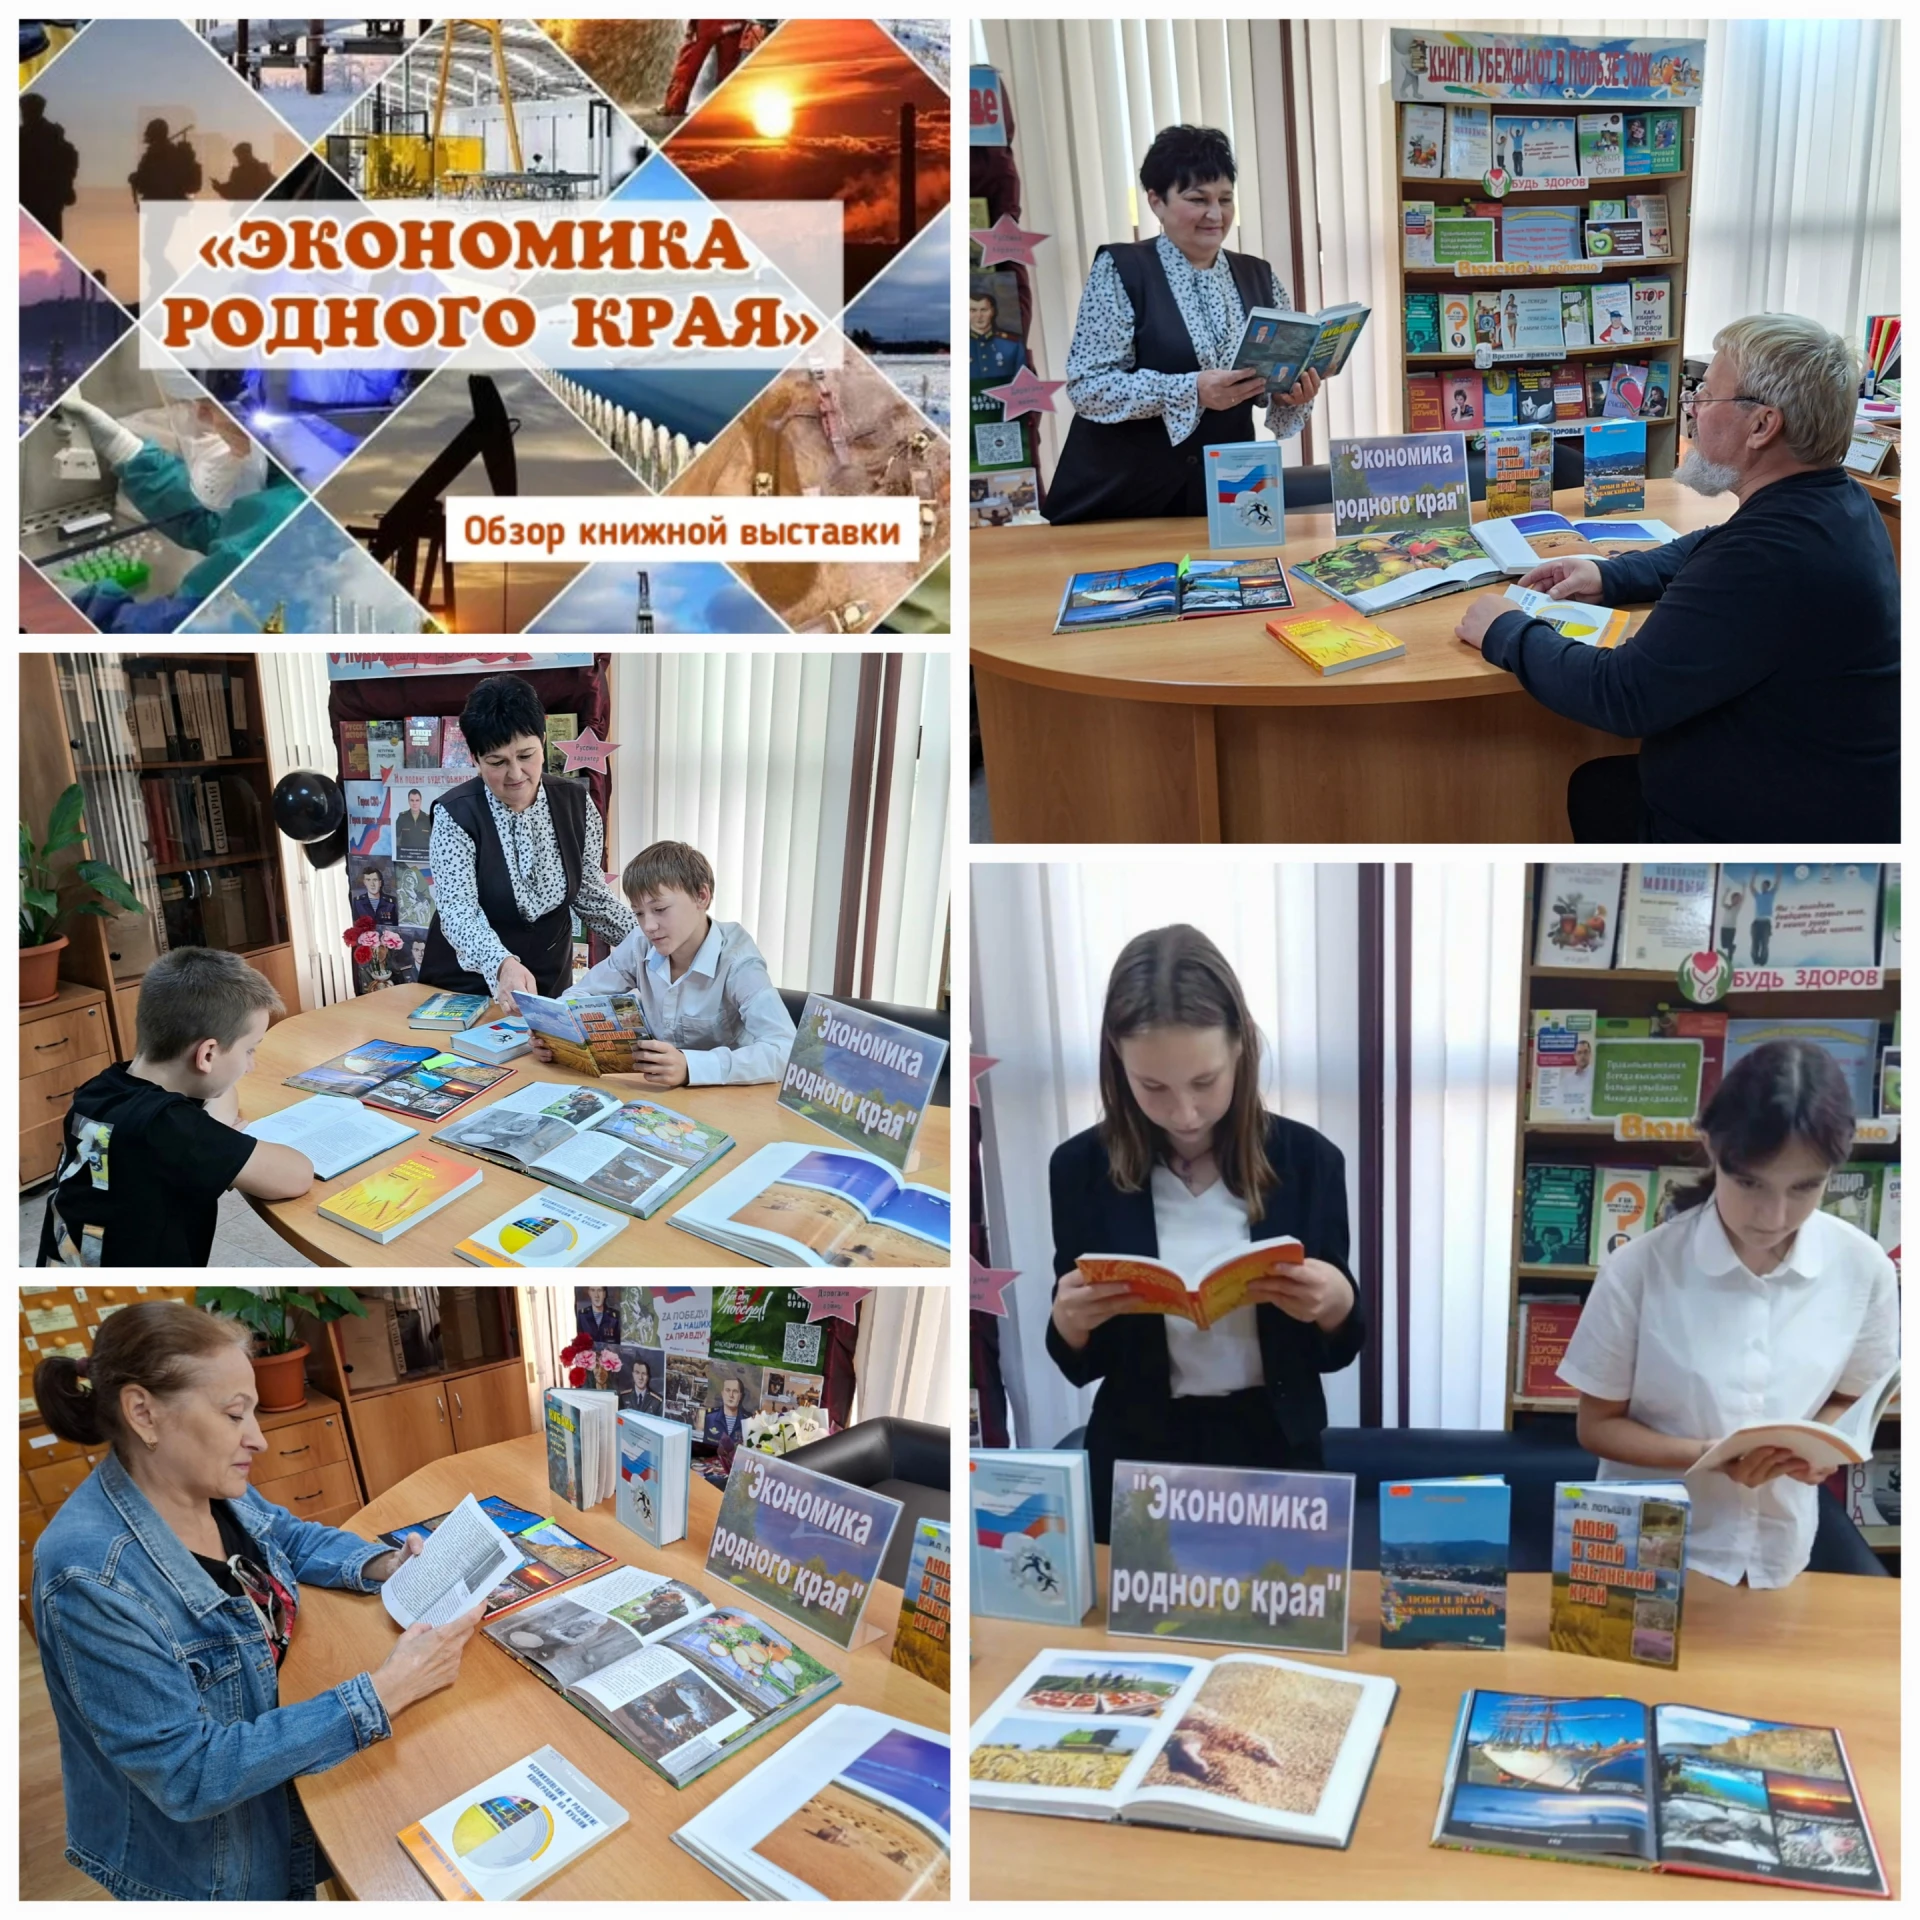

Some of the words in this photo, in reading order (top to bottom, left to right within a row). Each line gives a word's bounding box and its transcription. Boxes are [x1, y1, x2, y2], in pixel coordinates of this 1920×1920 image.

[1429, 45, 1475, 82] КНИГИ
[1478, 47, 1554, 90] УБЕЖДАЮТ
[1556, 50, 1565, 85] В
[1568, 50, 1620, 86] ПОЛЬЗЕ
[1623, 51, 1652, 87] ЗОЖ
[1512, 178, 1539, 191] БУДЬ
[1544, 177, 1586, 190] ЗДОРОВ
[1458, 261, 1528, 276] Вкусно
[1548, 263, 1599, 273] полезно
[1635, 290, 1665, 301] STOP
[1552, 427, 1582, 436] ДОРОВЬЕ
[1341, 444, 1453, 470] "Экономика
[1335, 495, 1410, 526] родного
[1416, 484, 1465, 518] края"
[1733, 971, 1784, 990] БУДЬ
[1795, 969, 1879, 988] ЗДОРОВ
[814, 1003, 923, 1078] "Экономика
[782, 1062, 854, 1115] родного
[856, 1097, 917, 1141] края"
[1620, 1113, 1697, 1140] Вкус
[744, 1459, 873, 1546] "Экономика
[1133, 1474, 1328, 1531] "Экономика
[1591, 1503, 1632, 1516] ЛОТЫШЕВ
[1573, 1518, 1617, 1540] ЛЮБИ
[1572, 1541, 1582, 1559] И
[1587, 1543, 1625, 1565] ЗНАЙ
[710, 1526, 791, 1586] родного
[793, 1566, 865, 1616] края"
[925, 1556, 950, 1579] ЛЮБ
[1570, 1562, 1656, 1592] КУБАНСКИЙ
[933, 1581, 950, 1602] ЗН
[1112, 1569, 1241, 1614] родного
[1252, 1573, 1341, 1626] края"
[1569, 1583, 1608, 1606] КРАЙ
[913, 1612, 946, 1640] КРАЙ
